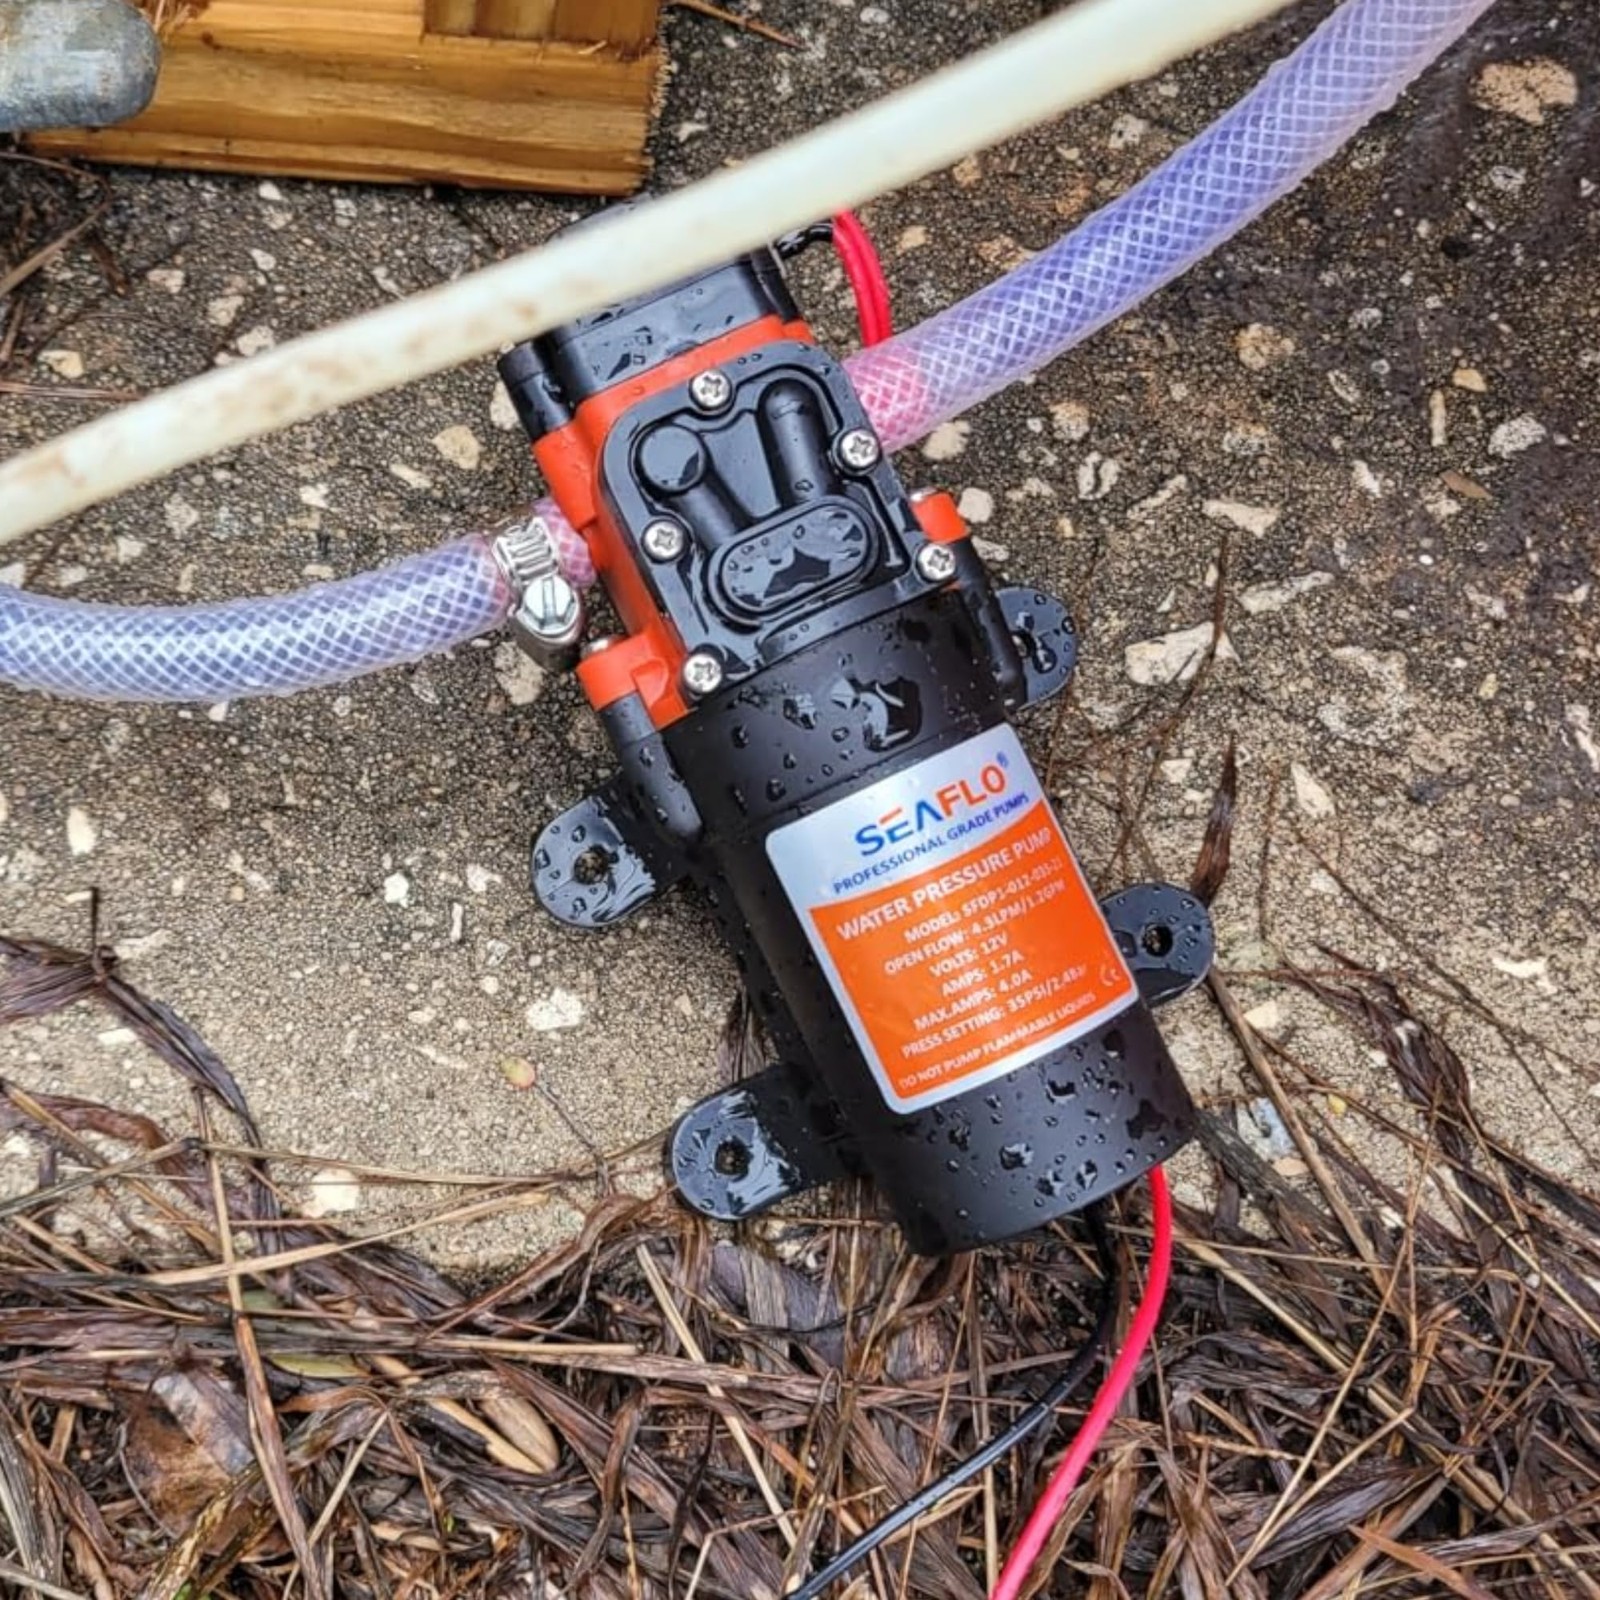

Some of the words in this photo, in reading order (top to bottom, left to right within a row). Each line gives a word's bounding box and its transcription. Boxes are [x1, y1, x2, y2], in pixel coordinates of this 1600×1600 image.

[832, 835, 946, 895] PROFESSIONAL
[947, 811, 993, 841] GRADE
[992, 791, 1030, 818] PUMPS
[836, 897, 912, 940] WATER
[912, 847, 1014, 907] PRESSURE
[1012, 826, 1052, 860] PUMP
[903, 910, 961, 943] MODEL:
[884, 946, 924, 974] OPEN
[923, 929, 969, 957] FLOW:
[929, 948, 979, 977] VOLTS:
[980, 931, 1009, 955] 12V
[942, 967, 988, 996] AMPS:
[989, 950, 1025, 974] 1.7A
[998, 969, 1033, 993] 4.0A
[900, 1074, 917, 1089] DO
[918, 1063, 943, 1082] NOT
[943, 1047, 983, 1072] PUMP
[982, 1011, 1057, 1056] FLAMMABLE
[901, 1032, 943, 1059] PRESS
[941, 1006, 1006, 1042] SETTING:
